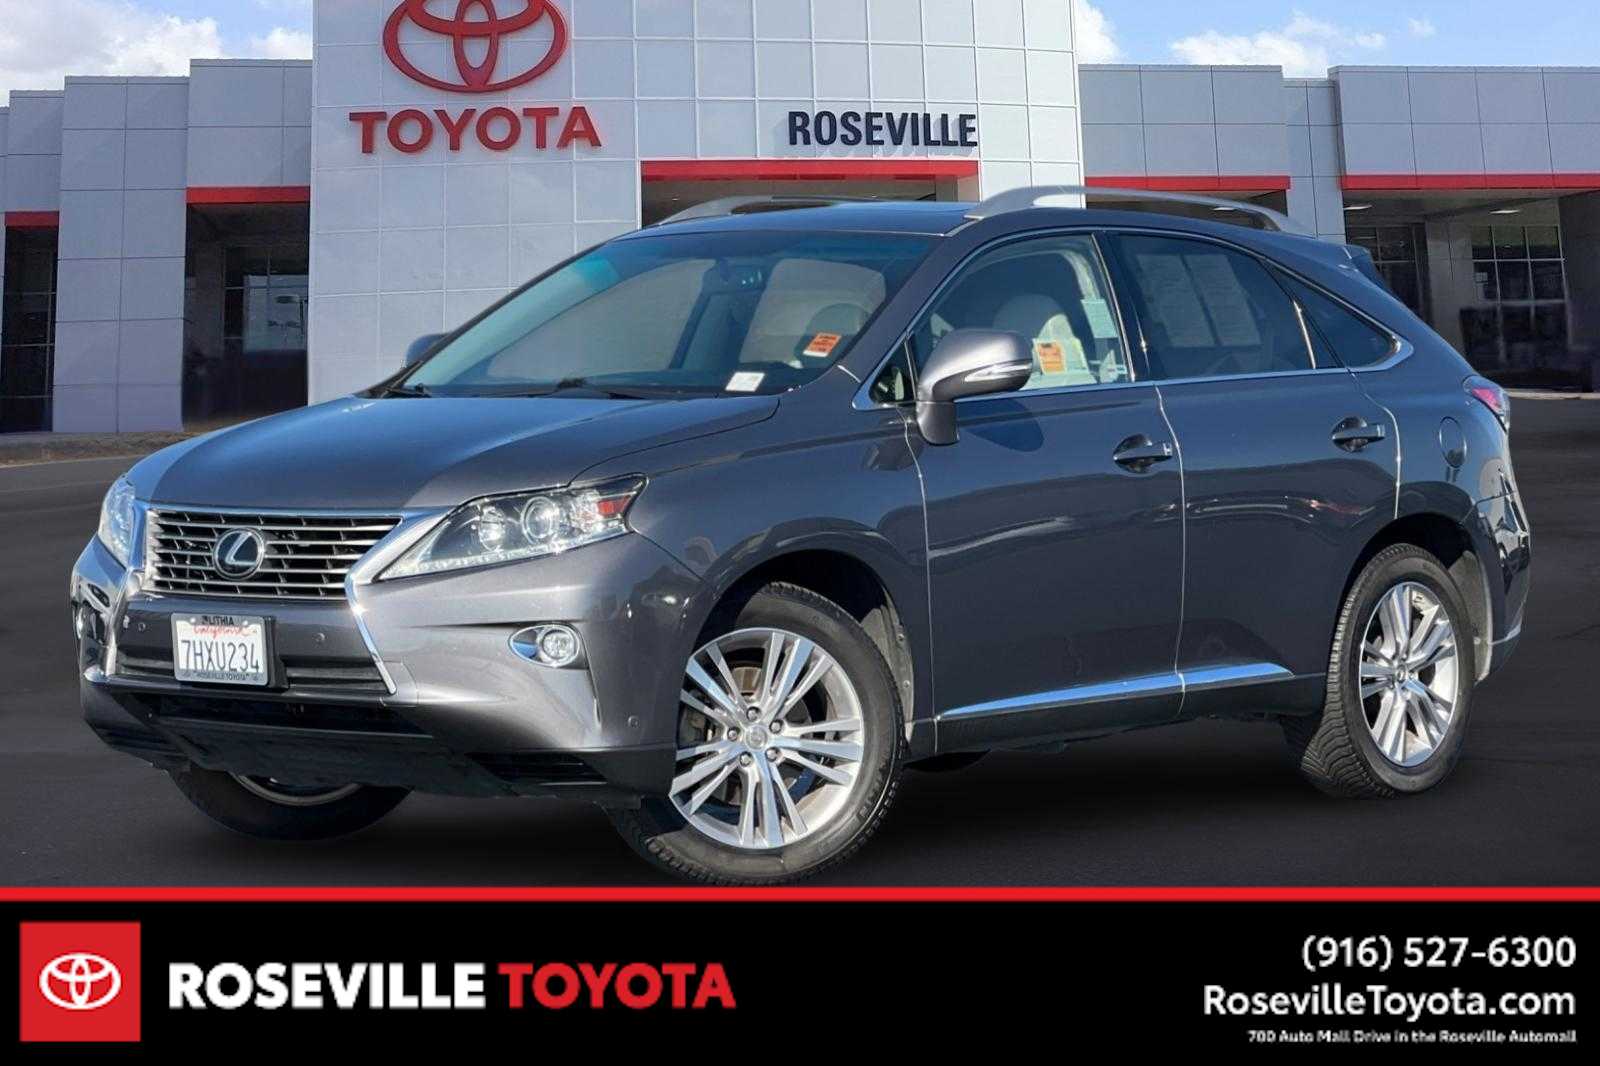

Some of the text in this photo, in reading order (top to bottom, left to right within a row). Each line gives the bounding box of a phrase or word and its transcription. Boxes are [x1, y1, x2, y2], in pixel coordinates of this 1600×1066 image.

[349, 106, 602, 154] TOYOTA
[788, 110, 978, 147] ROSEVILLE
[208, 615, 235, 626] LITHIA
[180, 640, 260, 673] 7HXU234
